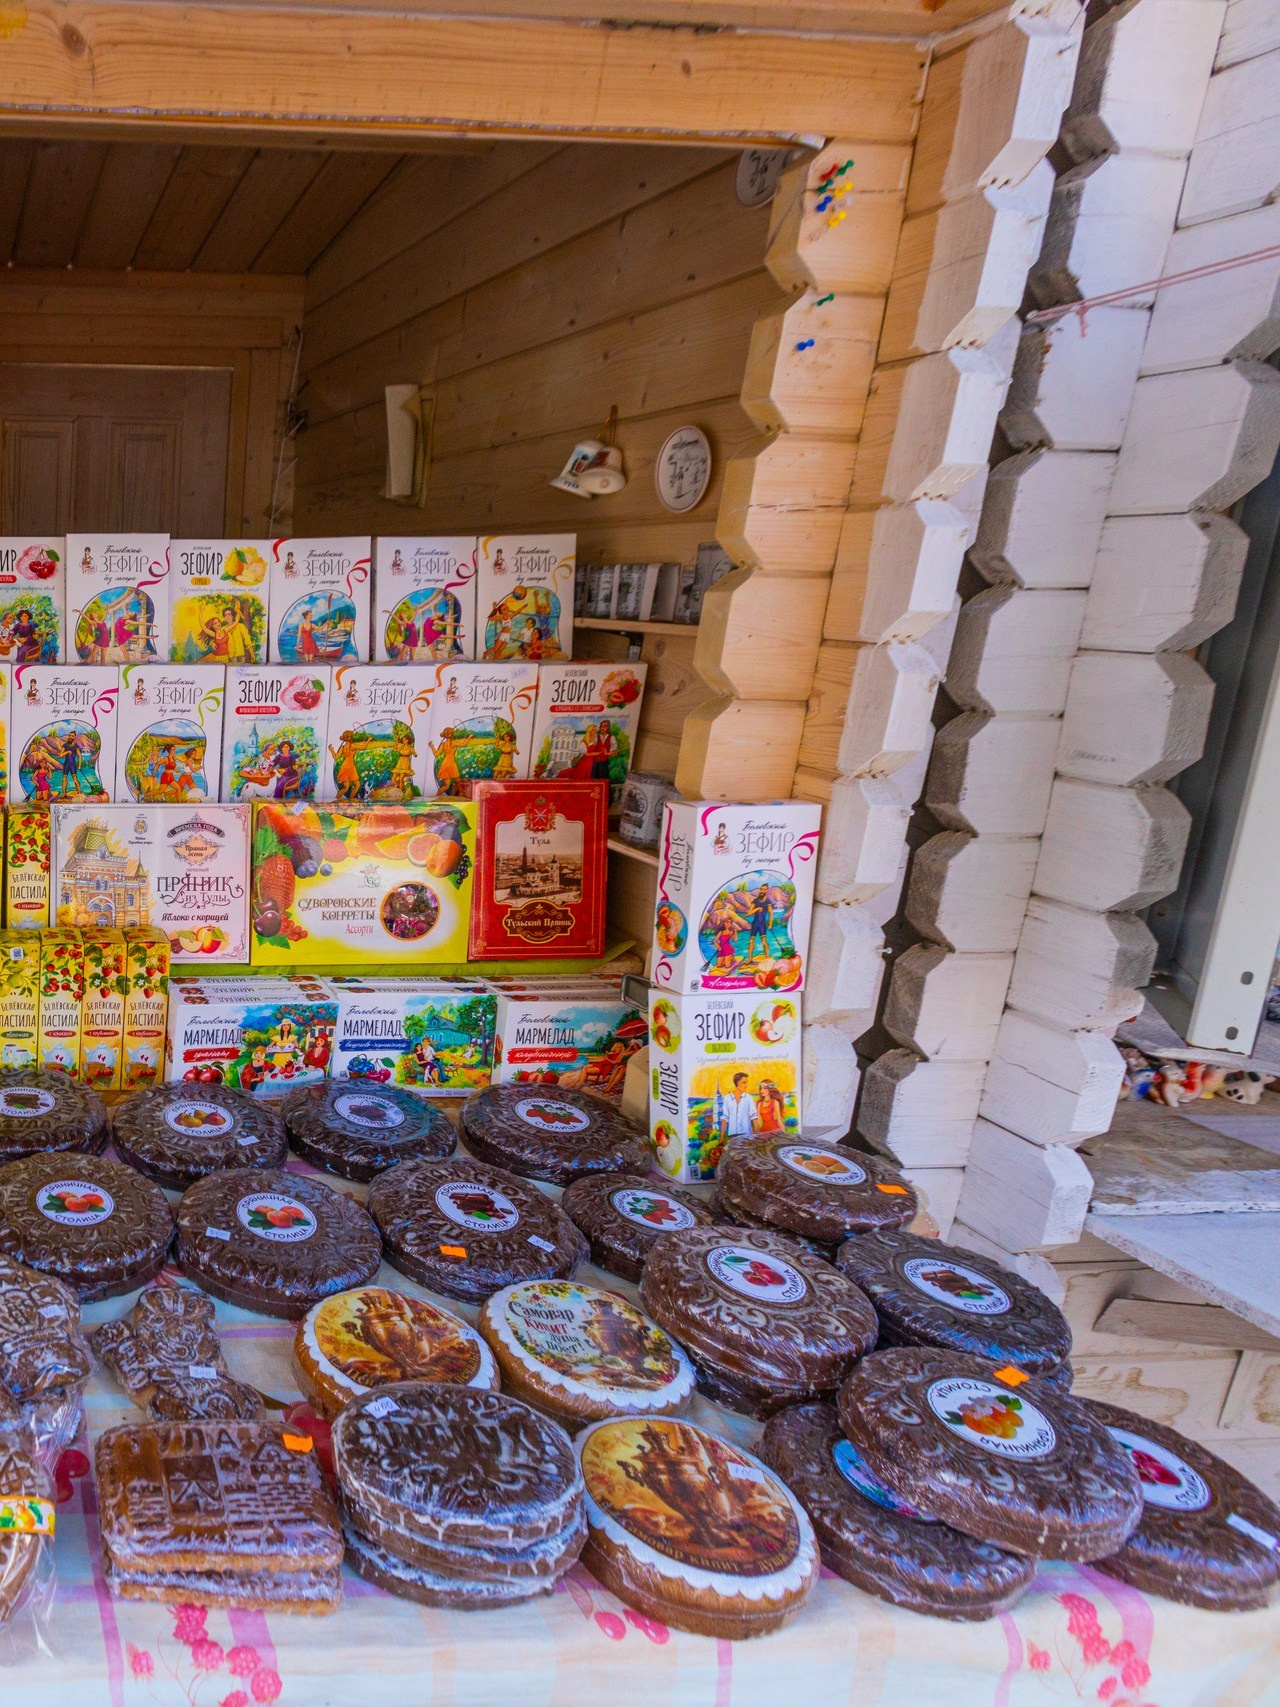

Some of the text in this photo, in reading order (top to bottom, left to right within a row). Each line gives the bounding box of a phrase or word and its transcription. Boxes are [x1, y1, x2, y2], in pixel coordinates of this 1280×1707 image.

[100, 555, 149, 573] ЗЕФИР
[180, 552, 222, 576] ЗЕФИР
[303, 559, 352, 577] ЗЕФИР
[410, 557, 457, 574] ЗЕФИР
[510, 556, 557, 573] ЗЕФИР
[46, 688, 96, 706] ЗЕФИР
[152, 687, 203, 704] ЗЕФИР
[239, 680, 282, 703] ЗЕФИР
[364, 688, 413, 706] ЗЕФИР
[465, 685, 515, 703] ЗЕФИР
[552, 679, 596, 703] ЗЕФИР
[530, 836, 551, 846] Тула
[736, 832, 795, 854] ЗЕФИР
[668, 830, 686, 892] ЗЕФИР
[10, 885, 47, 899] ПАСТИЛА
[157, 873, 239, 897] ПРЯНИК
[186, 894, 198, 904] из
[298, 898, 377, 912] СУВОРОВСКИЕ
[161, 912, 229, 923] Яблоко корицей
[321, 911, 375, 921] КОНФЕТЫ
[506, 918, 573, 929] Тульский Пряник
[345, 924, 374, 936] Ассорти
[44, 1002, 78, 1011] БЕЛЁВСКАЯ
[86, 1001, 120, 1011] БЕЛЁВСКАЯ
[129, 1001, 163, 1011] БЕЛЁВСКАЯ
[41, 1014, 79, 1027] ПАСТИЛА
[84, 1013, 121, 1026] ПАСТИЛА
[127, 1013, 165, 1027] ПАСТИЛА
[694, 1012, 745, 1041] ЗЕФИР
[184, 1028, 244, 1046] МАРМЕЛАД
[343, 1019, 403, 1038] МАРМЕЛАД
[515, 1027, 575, 1046] МАРМЕЛАД
[659, 1061, 679, 1116] ЗЕФИР
[171, 1102, 220, 1114] ПРЯНИЧНАЯ
[183, 1125, 224, 1136] СТОЛИЦА
[534, 1120, 579, 1132] СТОЛИЦА
[45, 1180, 99, 1195] ПРЯНИЧНАЯ
[440, 1181, 494, 1198] ПРЯНИЧНАЯ
[242, 1193, 294, 1209] ПРЯНИЧНАЯ
[53, 1212, 102, 1225] СТОЛИЦА
[463, 1217, 510, 1232] СТОЛИЦА
[264, 1228, 310, 1241] СТОЛИЦА
[708, 1247, 735, 1283] ПРЯНИЧНАЯ
[780, 1268, 804, 1299] СТОЛИЦА
[508, 1300, 575, 1324] Самовар
[962, 1296, 1007, 1314] СТОЛИЦА
